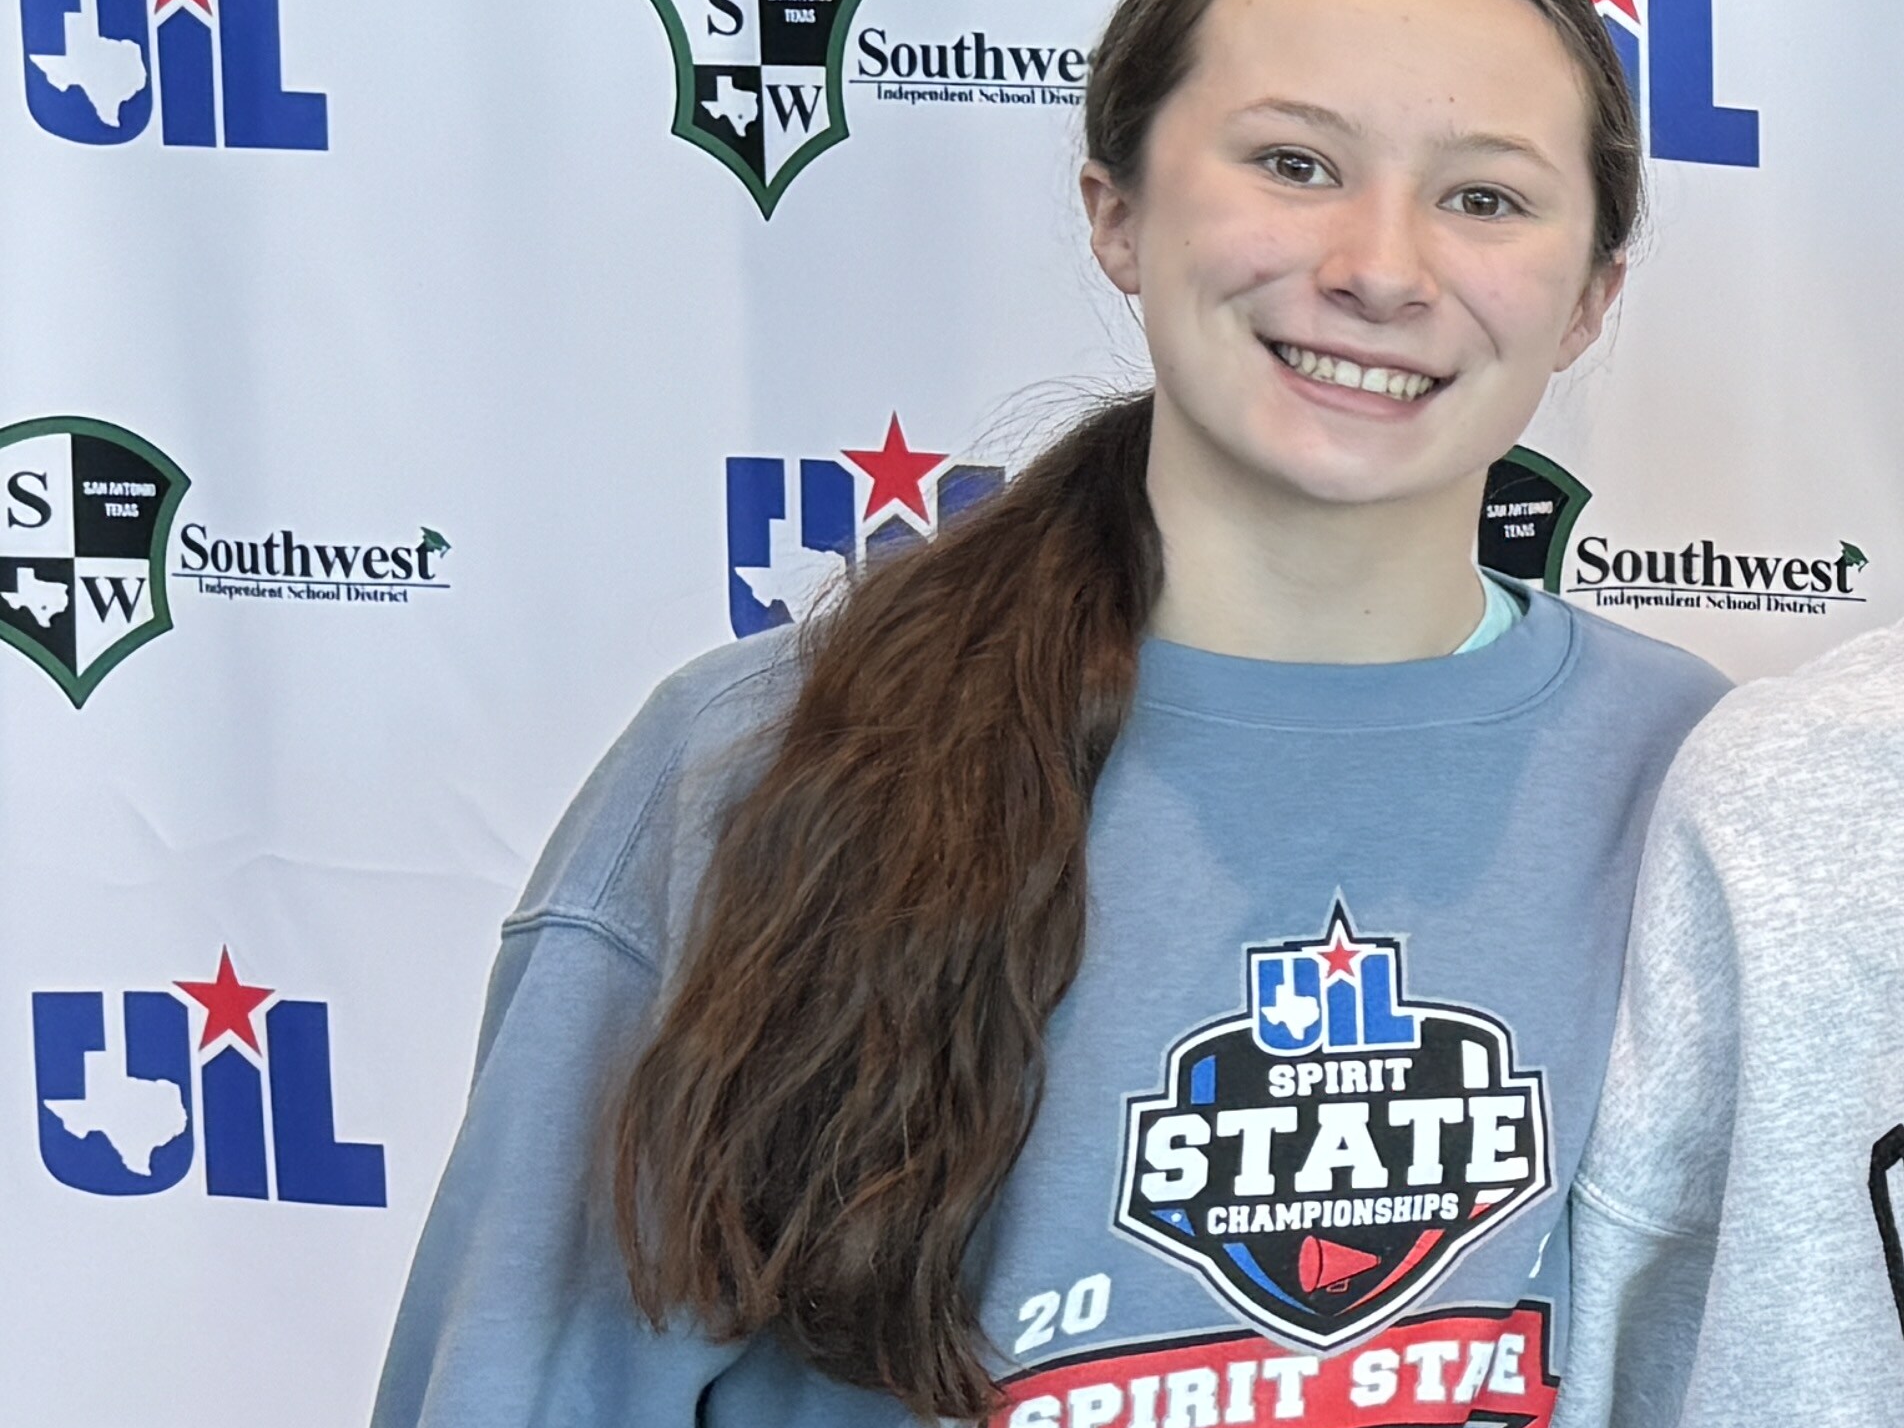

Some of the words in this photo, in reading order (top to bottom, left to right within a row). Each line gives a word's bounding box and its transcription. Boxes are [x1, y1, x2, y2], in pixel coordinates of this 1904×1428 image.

[857, 27, 1085, 83] Southwe
[766, 84, 822, 133] W
[4, 471, 53, 530] S
[180, 523, 436, 582] Southwest
[1576, 537, 1855, 595] Southwest
[78, 576, 145, 624] W
[1268, 1058, 1413, 1098] SPIRIT
[1139, 1095, 1530, 1203] STATE
[1206, 1192, 1460, 1236] CHAMPIONSHIPS
[1014, 1272, 1112, 1355] 20
